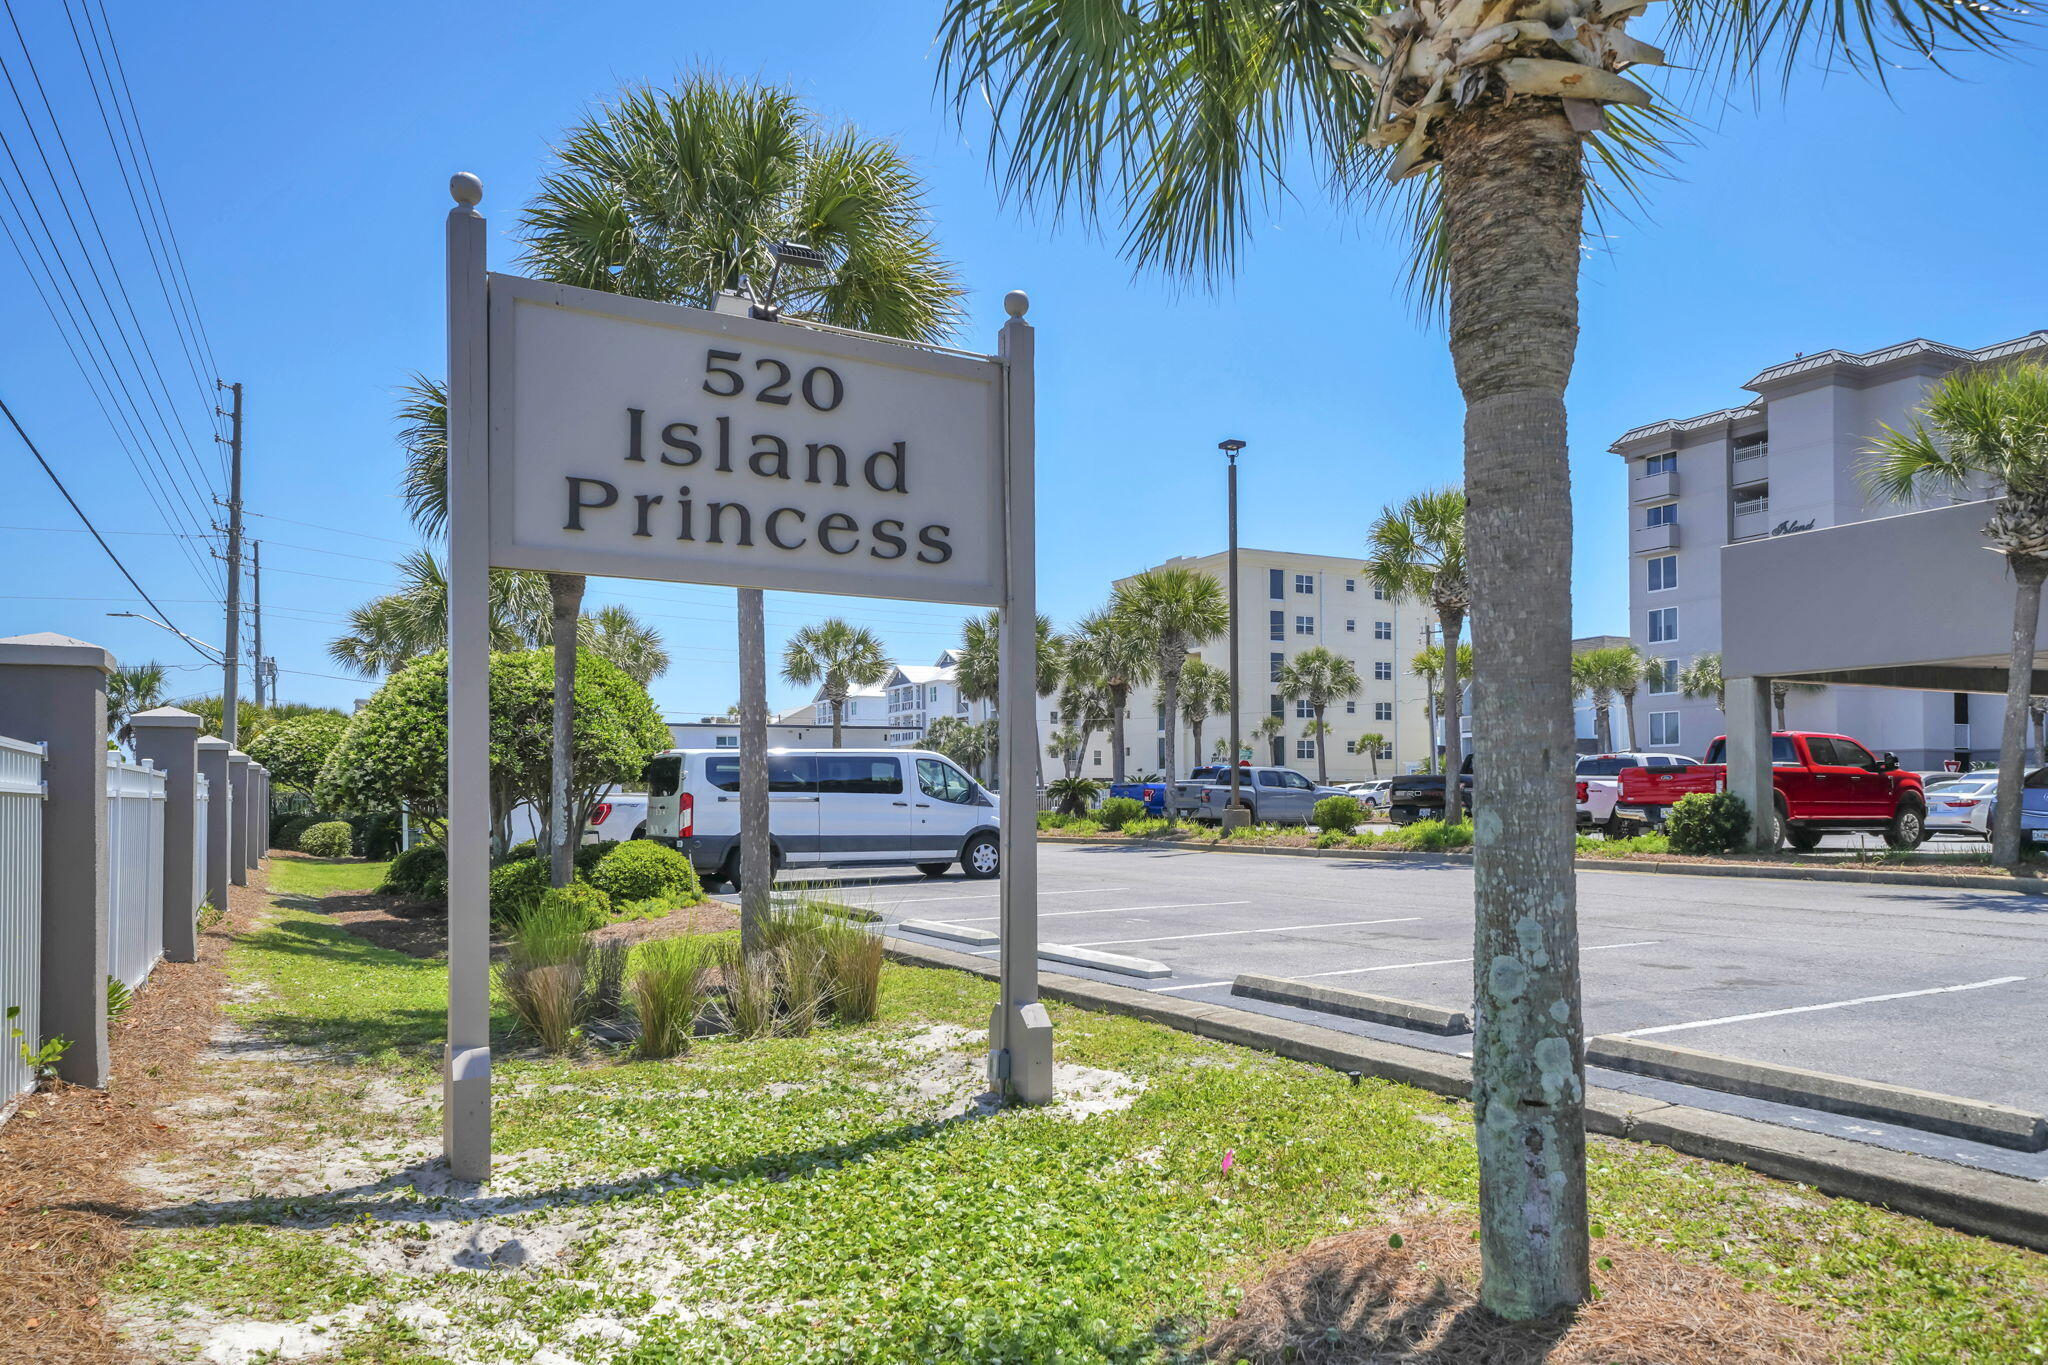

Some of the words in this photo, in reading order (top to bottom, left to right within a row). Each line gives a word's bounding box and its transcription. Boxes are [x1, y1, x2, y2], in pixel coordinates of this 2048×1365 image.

[702, 348, 844, 412] 520
[624, 407, 909, 494] Island
[562, 476, 953, 564] Princess
[1771, 518, 1816, 536] Island
